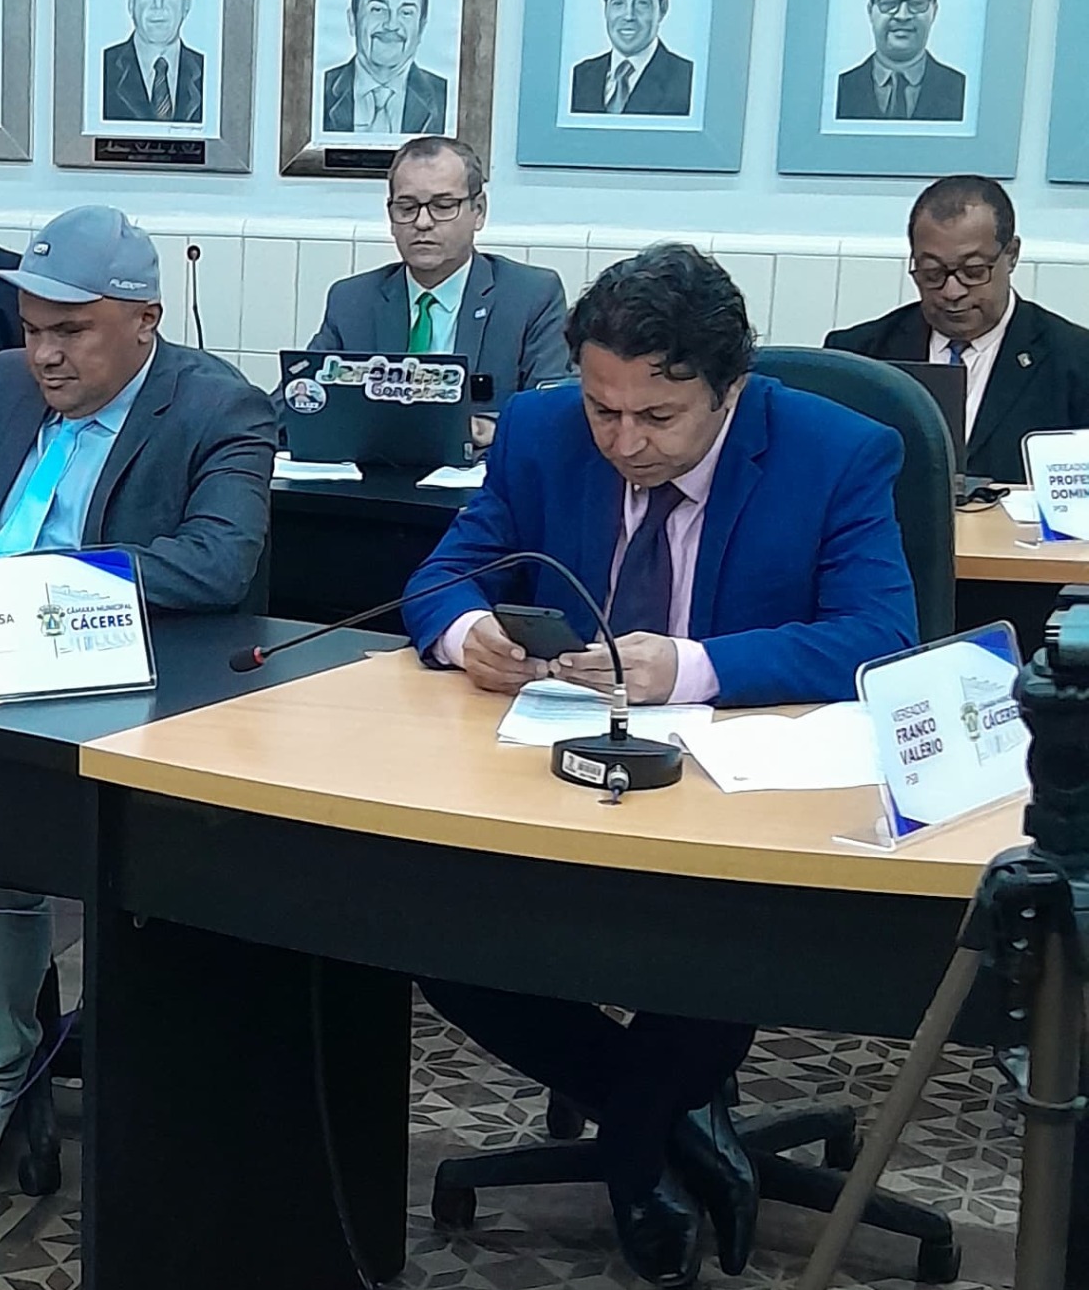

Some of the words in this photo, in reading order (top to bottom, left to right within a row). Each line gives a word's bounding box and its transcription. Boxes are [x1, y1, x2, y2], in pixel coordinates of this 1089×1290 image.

[1047, 463, 1089, 472] VEREADO
[1049, 474, 1089, 485] PROFE
[70, 613, 134, 631] CÁCERES
[982, 705, 1019, 730] CÁCERE
[896, 717, 936, 745] FRANCO
[899, 738, 943, 765] VALÉRIO
